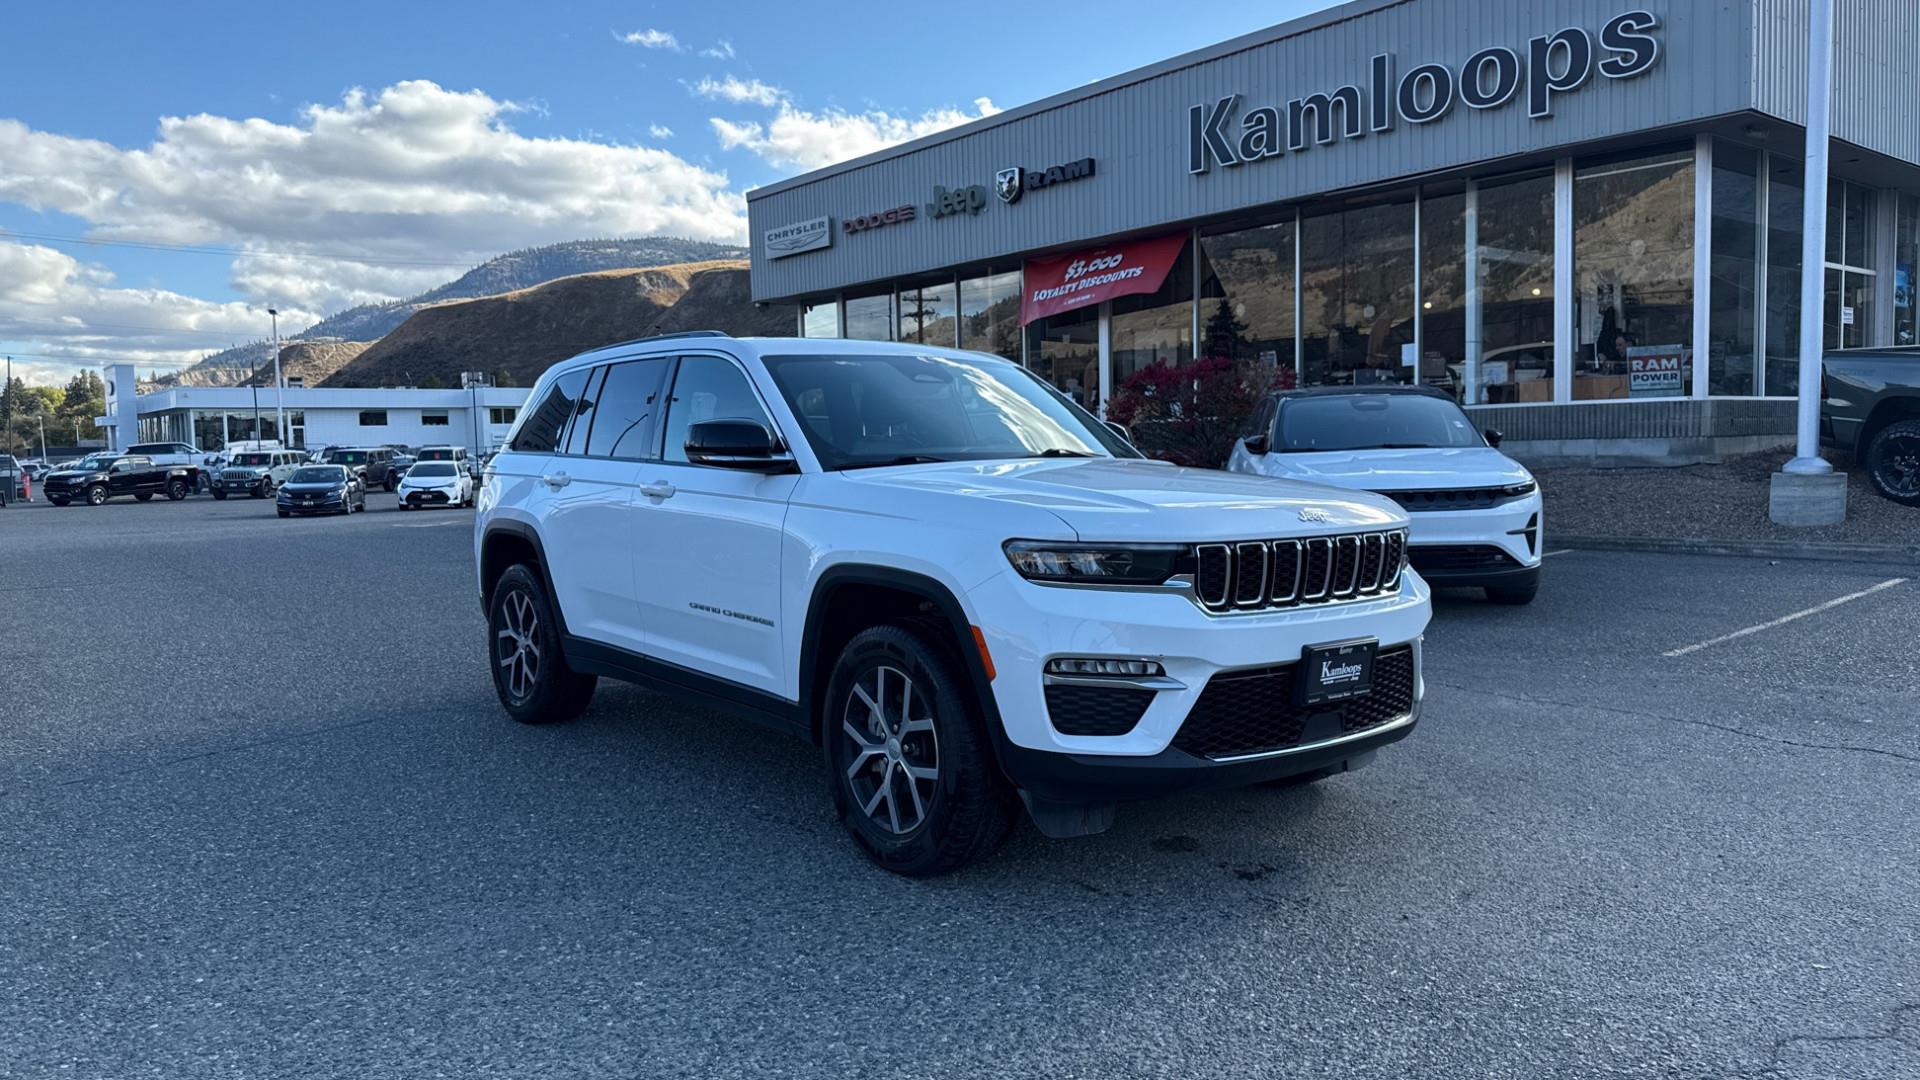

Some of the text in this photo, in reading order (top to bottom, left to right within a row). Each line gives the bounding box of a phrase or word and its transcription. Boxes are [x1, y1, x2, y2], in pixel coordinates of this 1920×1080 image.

[1188, 10, 1662, 175] Kamloops
[1024, 158, 1095, 190] RAM
[926, 185, 986, 219] Jeep
[767, 221, 825, 241] CHRYSLER
[841, 204, 916, 233] DODGE
[1064, 253, 1124, 281] $3,000
[1033, 282, 1079, 302] LOYALTY
[1078, 266, 1144, 290] DISCOUNTS
[1632, 358, 1678, 371] RAM
[1633, 373, 1678, 382] POWER
[1297, 510, 1327, 523] Jeep
[1320, 661, 1362, 679] Kamloops
